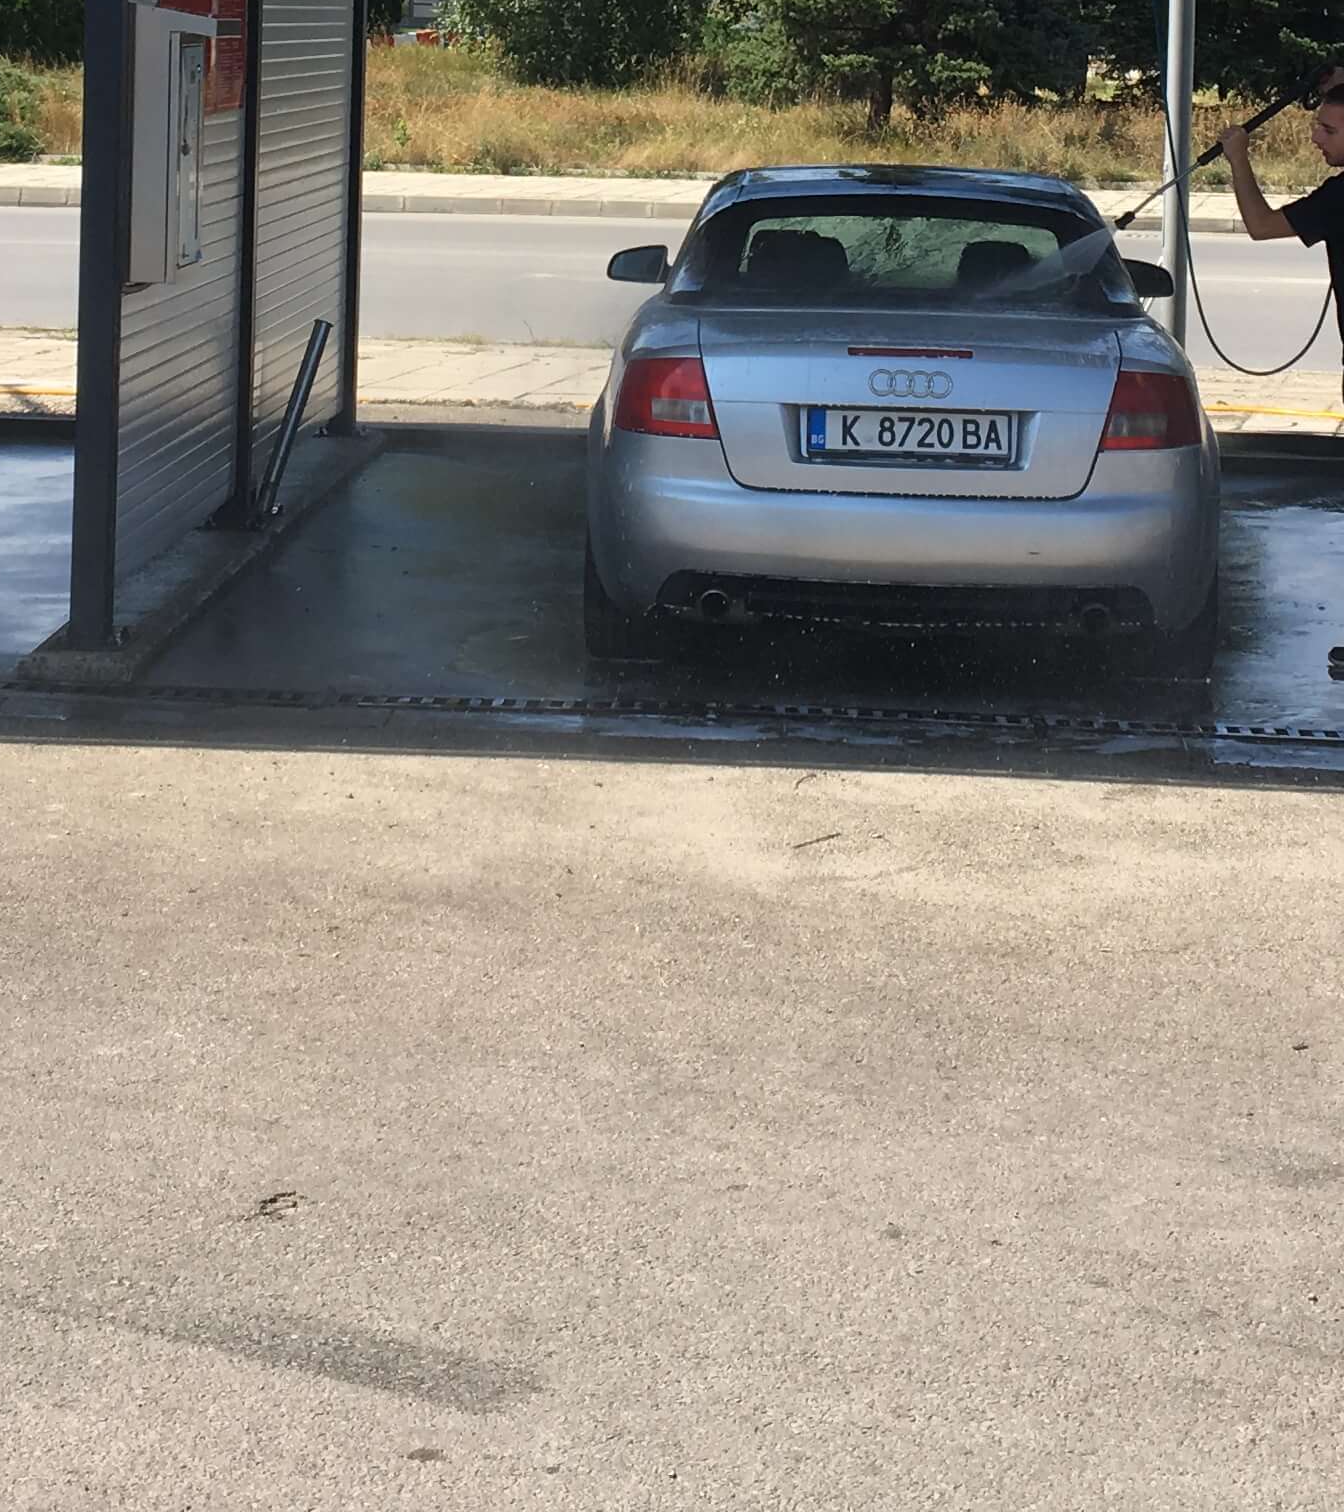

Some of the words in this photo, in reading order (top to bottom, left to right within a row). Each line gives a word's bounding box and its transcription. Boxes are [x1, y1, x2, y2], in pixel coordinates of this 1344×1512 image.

[841, 414, 862, 447] K
[877, 415, 955, 450] 8720
[961, 418, 1003, 451] BA
